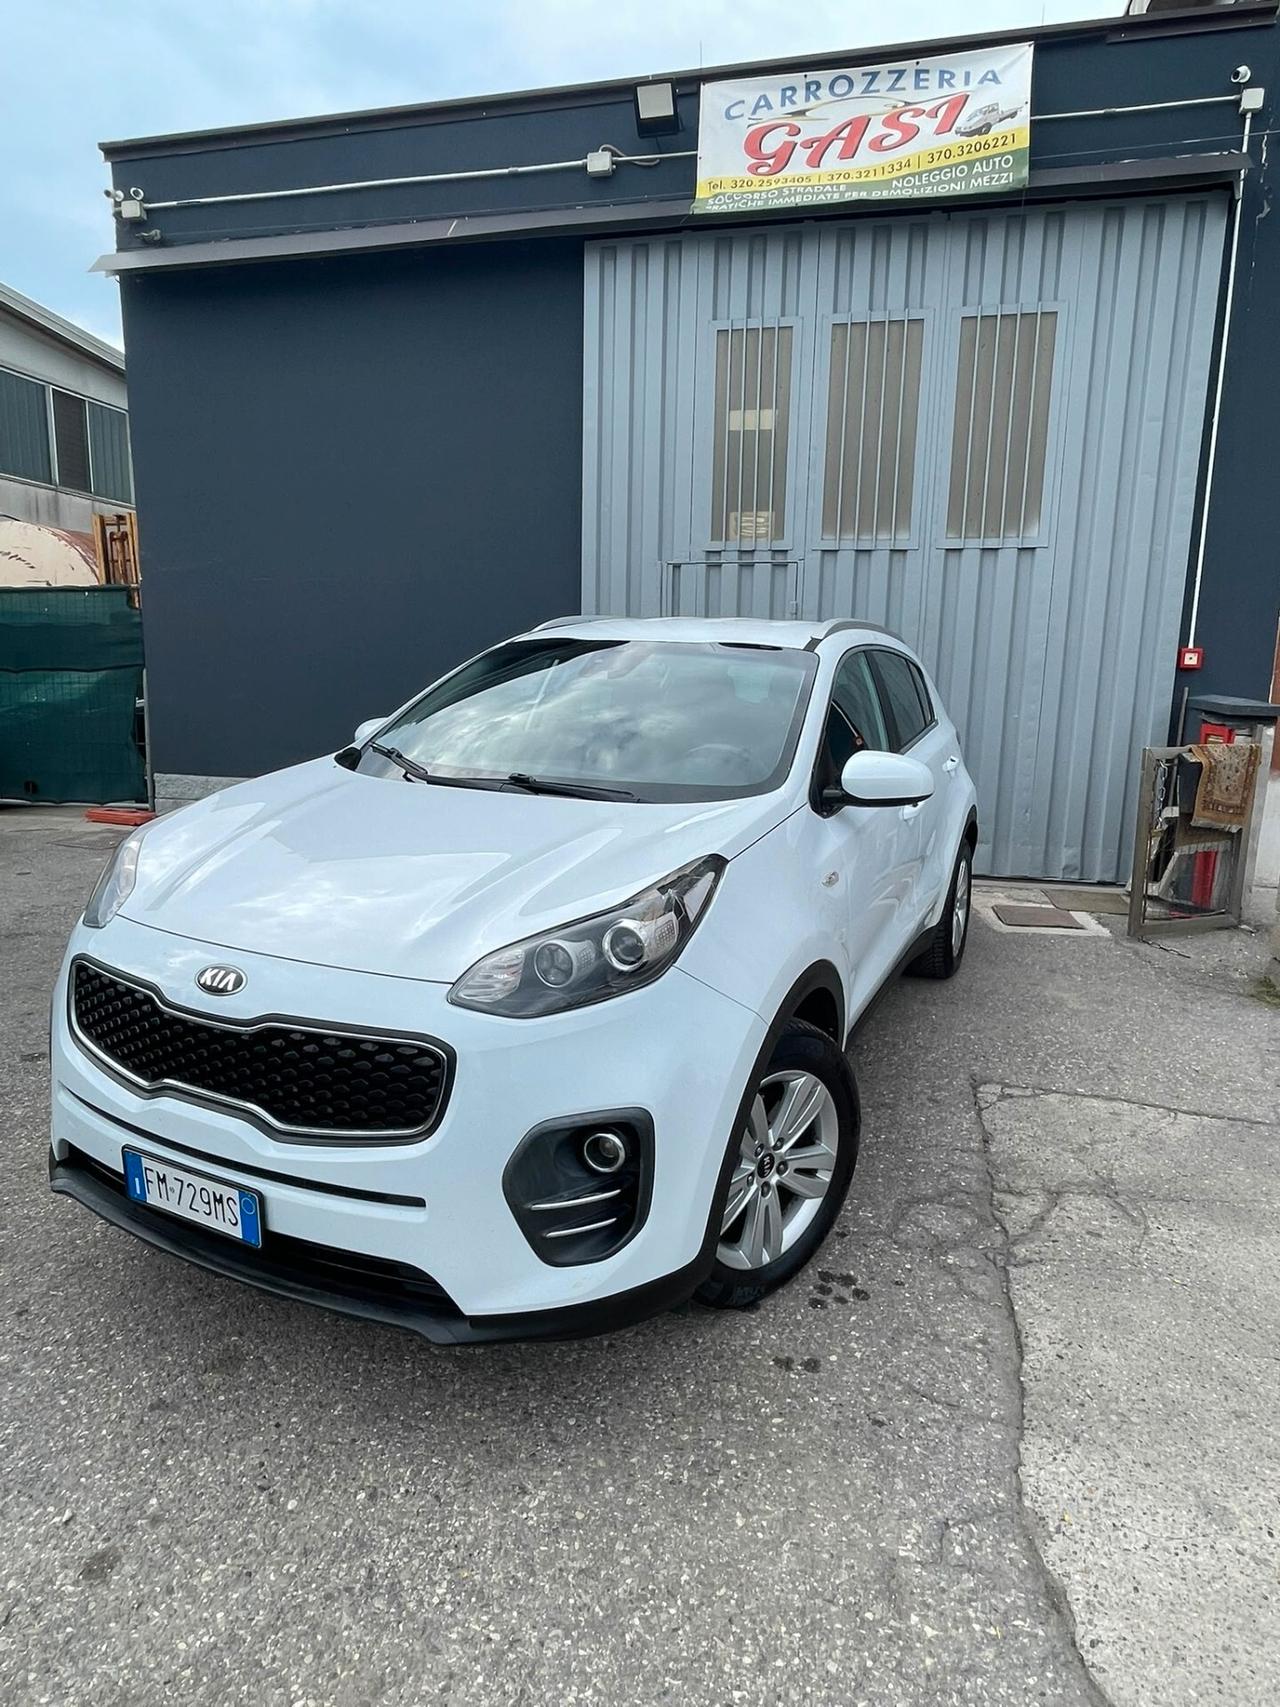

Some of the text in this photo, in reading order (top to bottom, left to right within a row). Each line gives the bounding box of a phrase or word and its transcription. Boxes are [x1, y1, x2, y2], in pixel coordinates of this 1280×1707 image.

[724, 69, 1001, 120] CARROZZERIA
[707, 180, 727, 192] Tel.
[731, 175, 811, 189] 320.2593405
[826, 159, 912, 183] 370.3211334
[927, 132, 1017, 164] 370.3206221
[893, 155, 1014, 188] NOLEGGIO AUTO
[707, 184, 847, 206] SOCCORSO STRADALE
[768, 193, 840, 207] IMMEDIATE
[844, 189, 868, 199] PER
[871, 181, 966, 198] DEMOLIZIONI
[969, 172, 1014, 189] MEZZI
[199, 968, 236, 992] KIA
[763, 1156, 771, 1177] KIA
